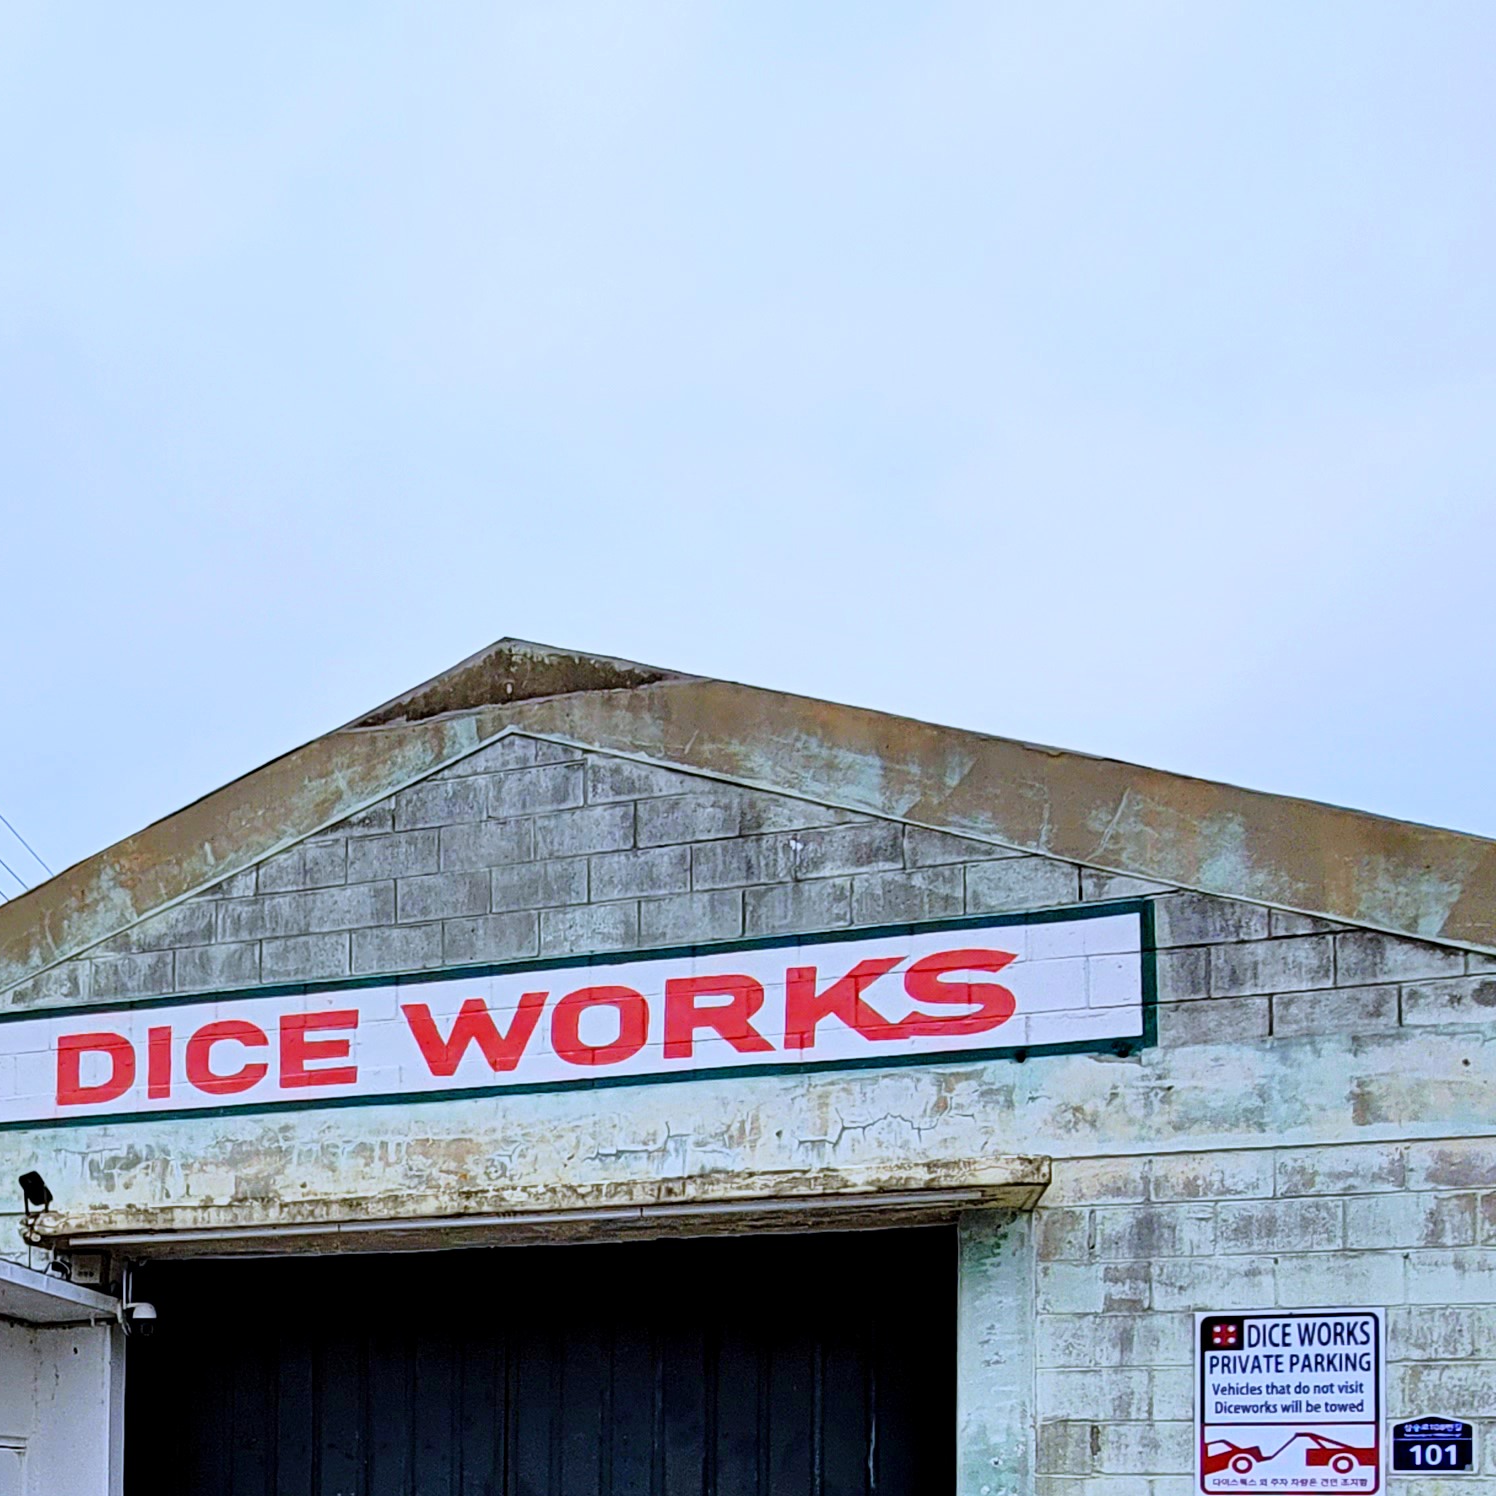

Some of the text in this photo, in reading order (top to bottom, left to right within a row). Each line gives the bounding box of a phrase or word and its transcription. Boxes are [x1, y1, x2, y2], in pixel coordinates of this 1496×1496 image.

[56, 949, 1018, 1107] DICE WORKS
[1248, 1321, 1371, 1348] DICE WORKS
[1209, 1352, 1371, 1375] PRIVATE PARKING
[1212, 1380, 1364, 1395] Vehicles that do not visit
[1214, 1399, 1364, 1414] Diceworks will be towed
[1409, 1444, 1457, 1466] 101
